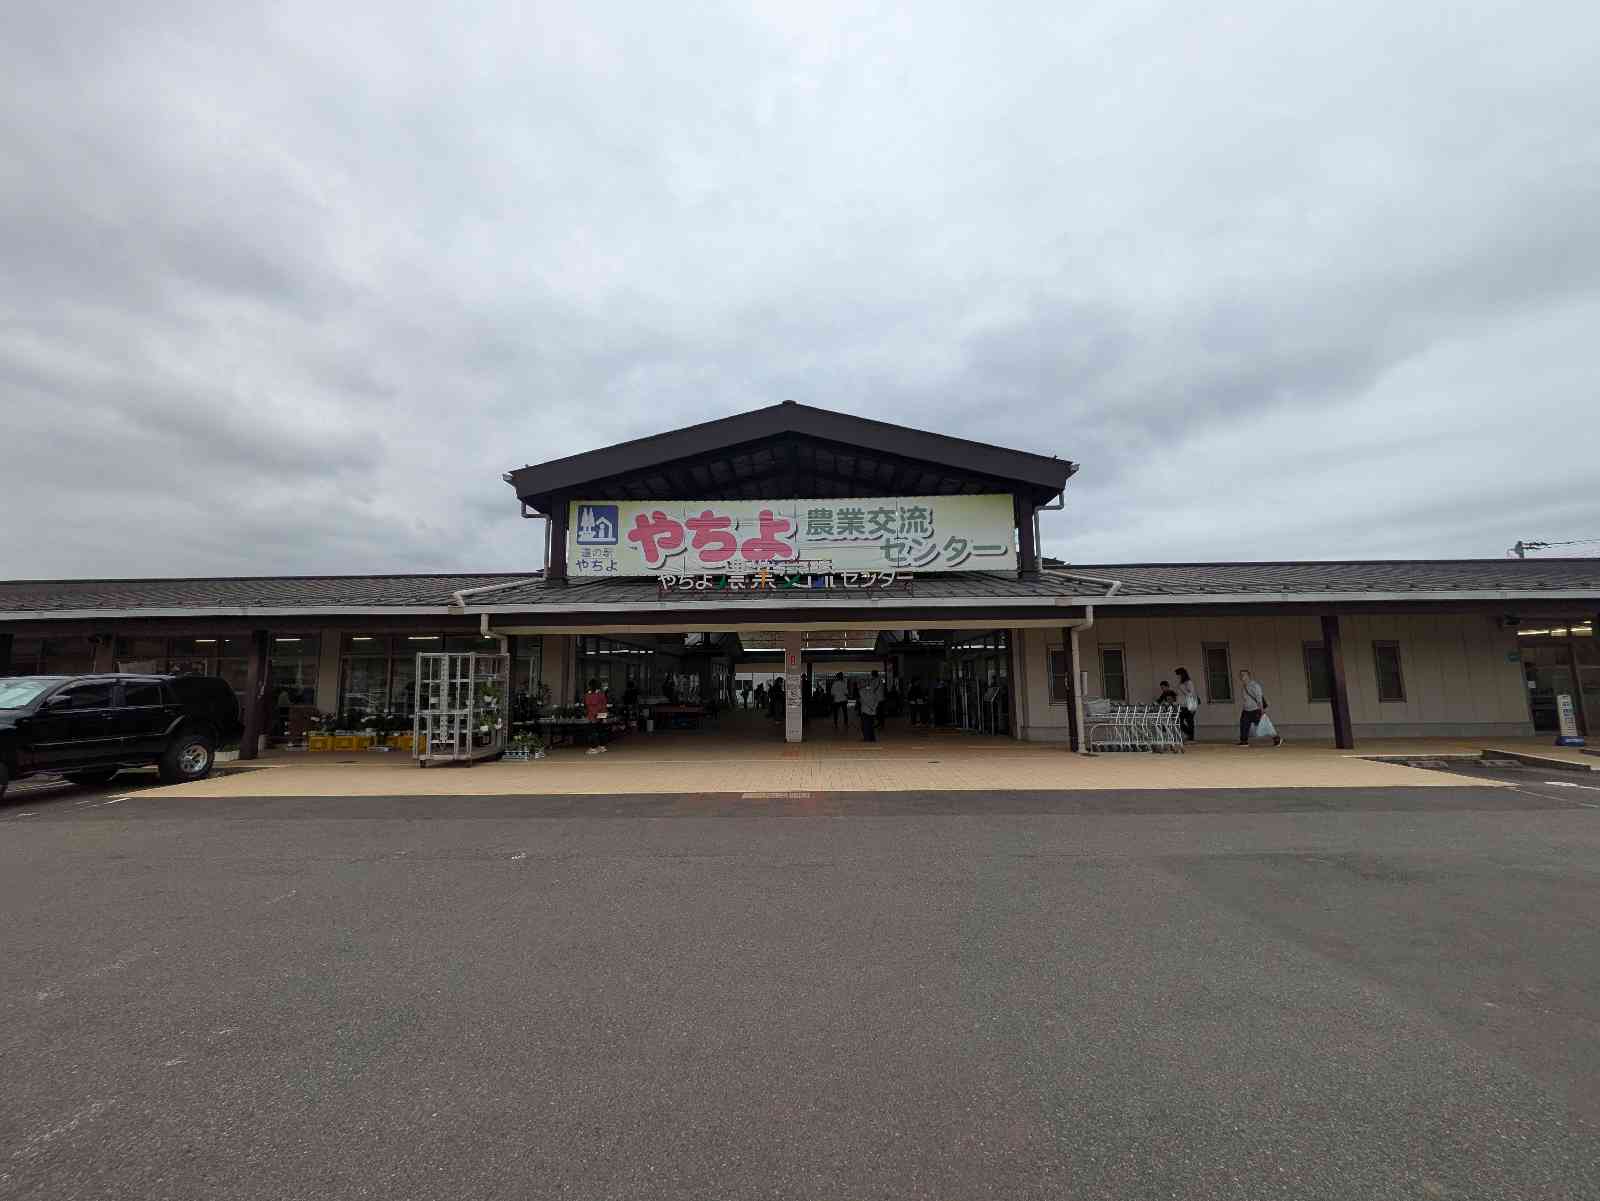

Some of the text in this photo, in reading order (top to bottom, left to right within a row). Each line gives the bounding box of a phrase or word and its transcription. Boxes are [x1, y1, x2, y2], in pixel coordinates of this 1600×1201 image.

[806, 508, 930, 536] 農業交流
[627, 510, 794, 563] やちよ
[880, 534, 1007, 563] センター
[576, 559, 618, 572] やちよ
